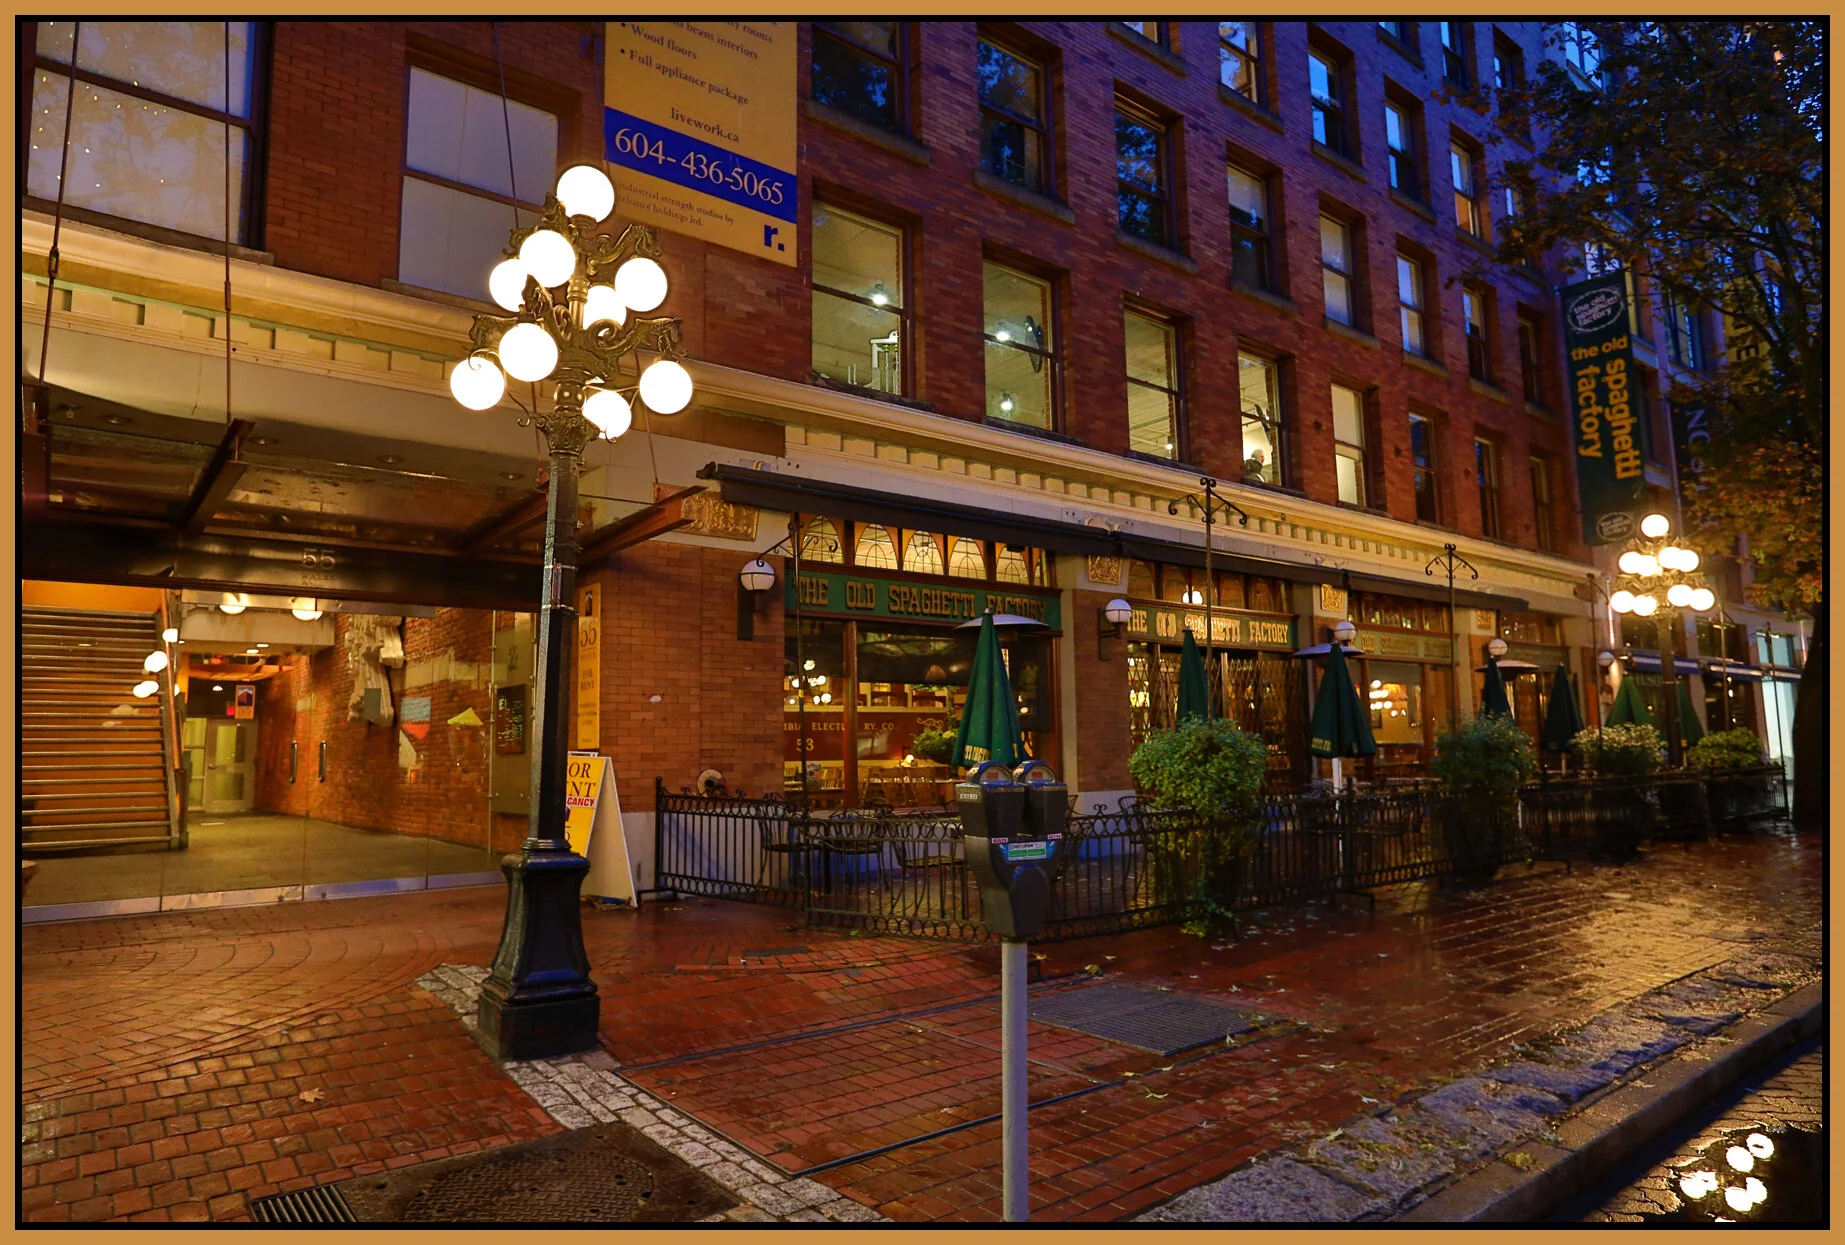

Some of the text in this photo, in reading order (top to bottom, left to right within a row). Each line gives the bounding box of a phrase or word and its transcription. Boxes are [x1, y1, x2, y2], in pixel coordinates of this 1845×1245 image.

[631, 24, 697, 60] Wood floors
[686, 22, 714, 41] beam
[717, 35, 758, 60] interiors
[743, 25, 773, 43] rooms
[629, 50, 749, 105] Full appliance package
[671, 107, 740, 143] livework.ca
[618, 183, 735, 225] industrial strength studios by
[618, 195, 704, 227] reliance holdings ltd.
[1571, 335, 1628, 361] the old
[1576, 365, 1603, 458] factory
[1602, 358, 1642, 479] spaghetti
[303, 548, 336, 570] 55
[794, 576, 1048, 622] THE OLD SPAGHETTI FACTORY
[1249, 621, 1289, 644] FACTORY
[568, 762, 592, 779] OR
[566, 797, 595, 807] CANCY
[568, 781, 596, 798] NT
